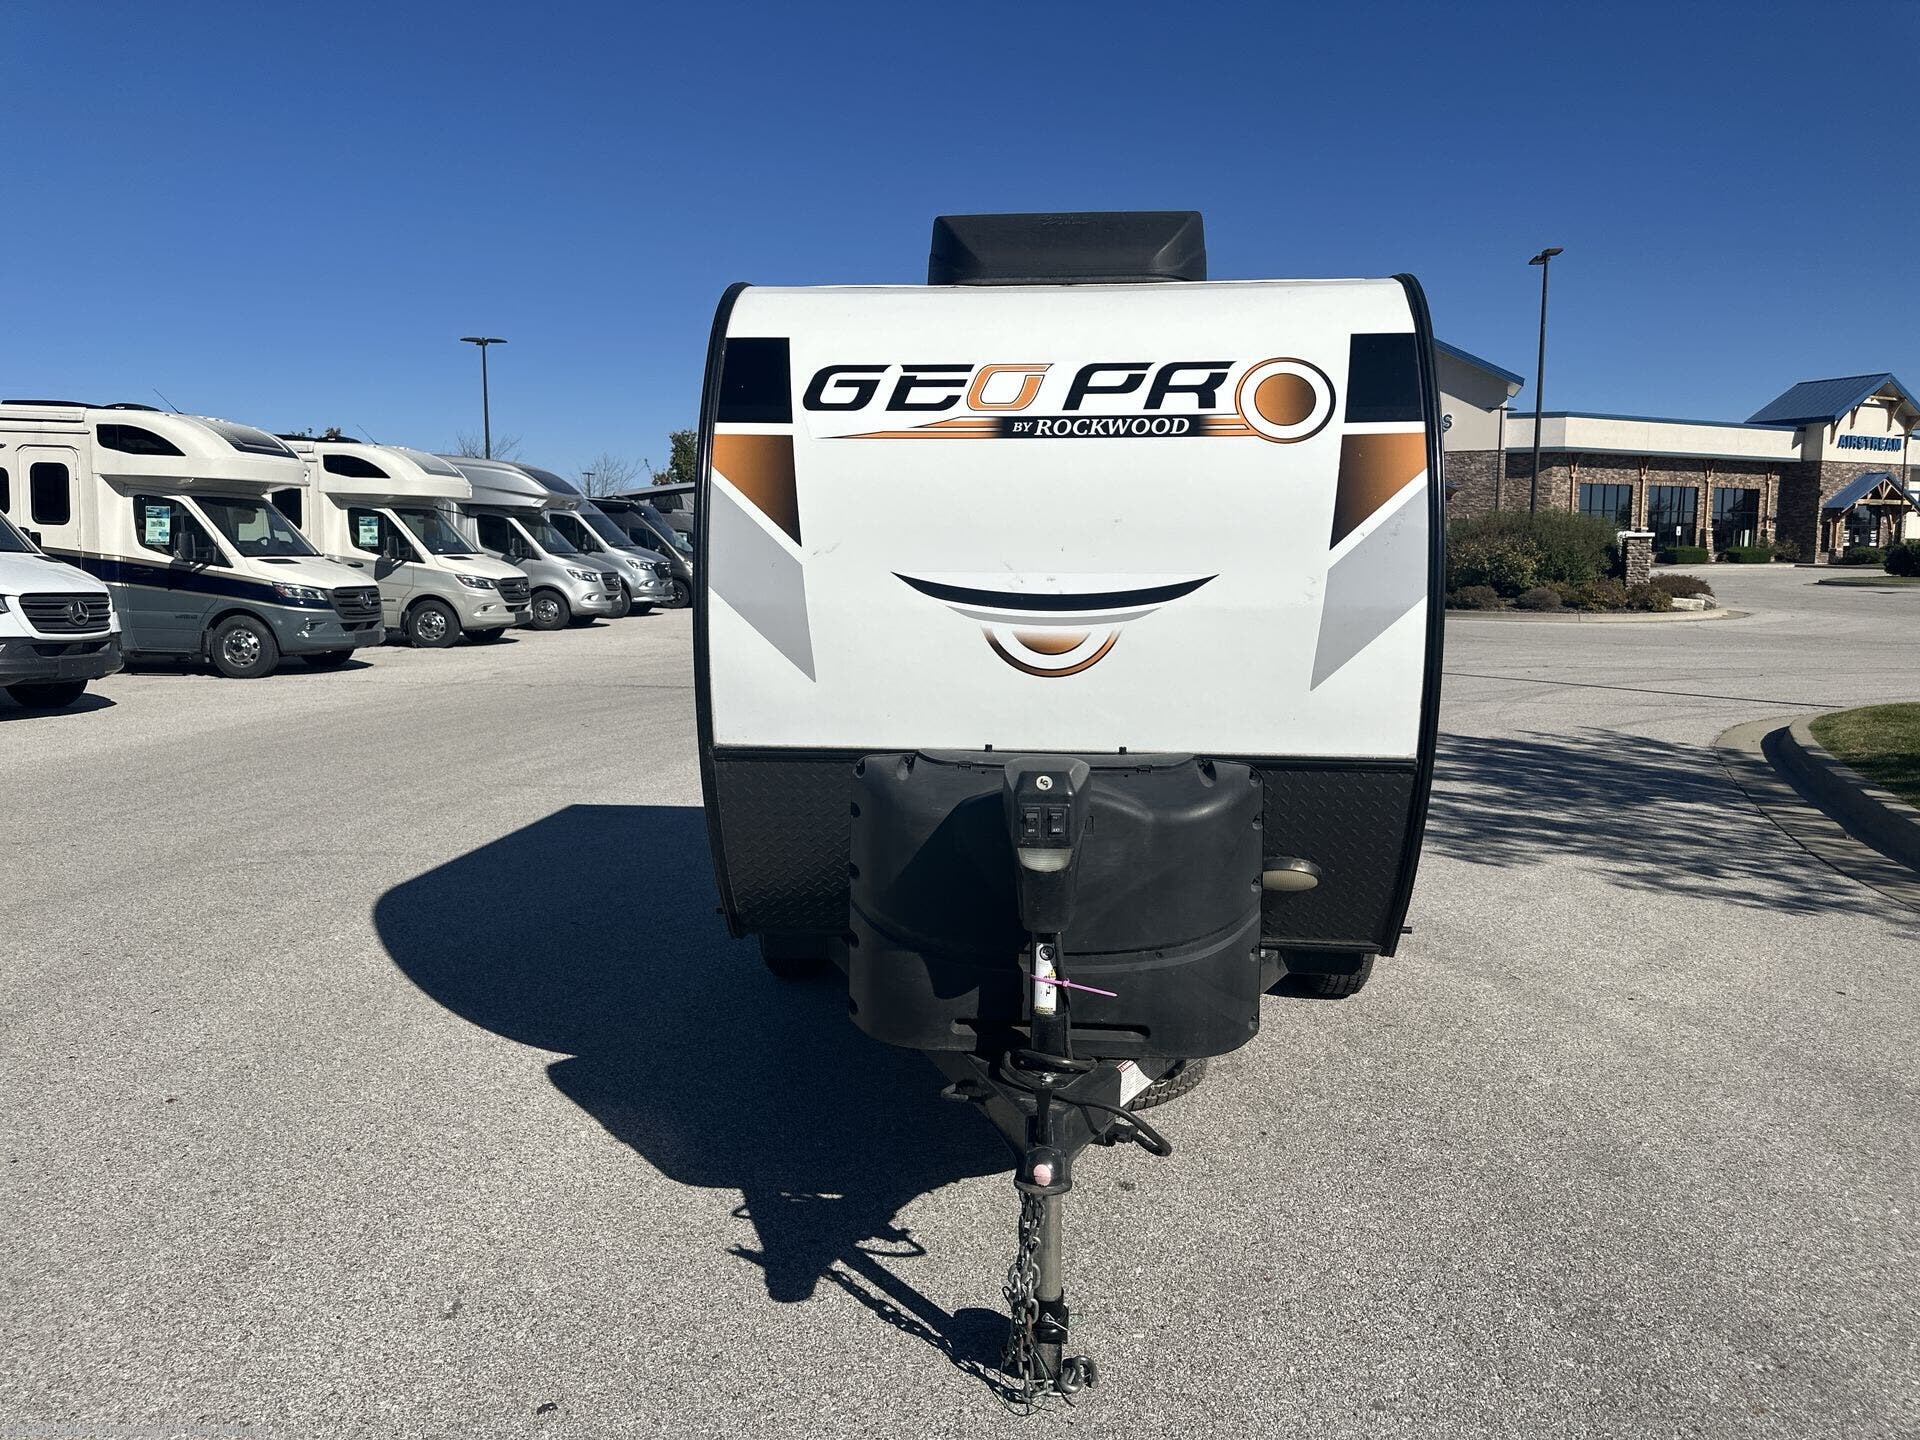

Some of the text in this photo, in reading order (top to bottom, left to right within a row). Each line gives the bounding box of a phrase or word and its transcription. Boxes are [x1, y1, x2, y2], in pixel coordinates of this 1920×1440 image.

[803, 363, 1054, 411] GEO
[1012, 417, 1190, 436] BY ROCKWOOD
[1837, 435, 1901, 452] AIRSTREAM
